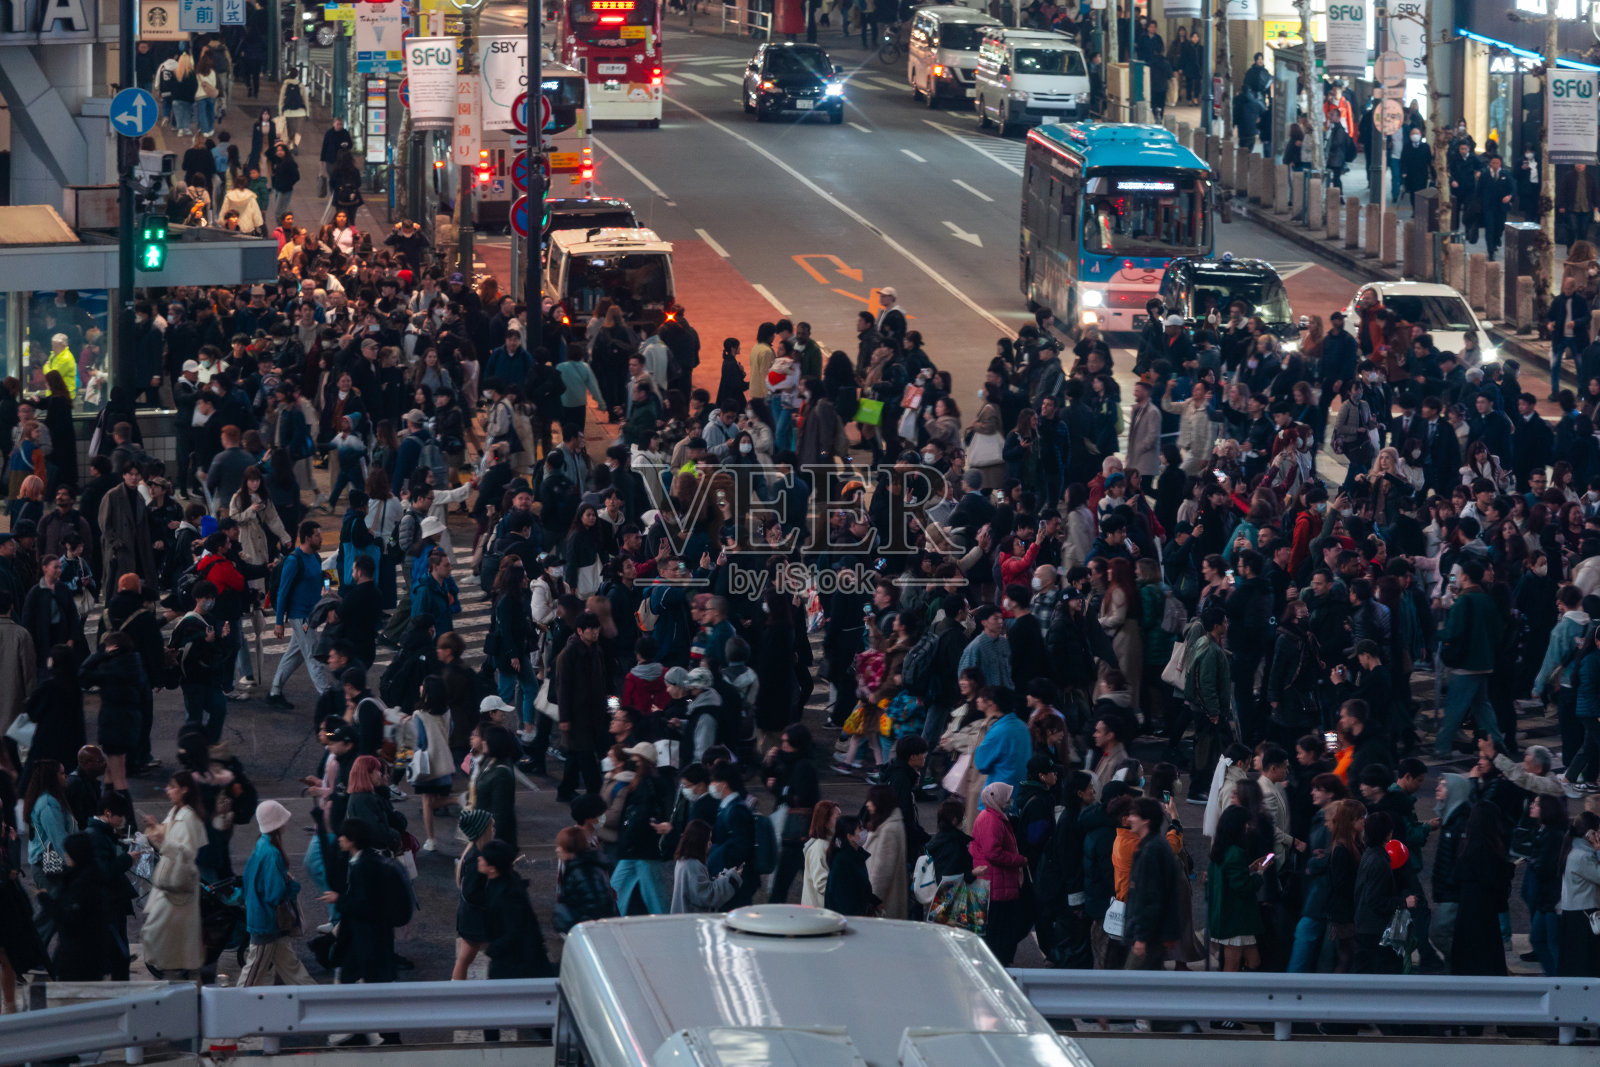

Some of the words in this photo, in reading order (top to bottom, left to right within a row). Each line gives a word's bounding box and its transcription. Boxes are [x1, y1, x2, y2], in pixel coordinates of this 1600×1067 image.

[1329, 5, 1363, 21] SFW
[491, 41, 518, 53] SBY
[412, 47, 452, 66] SFW
[517, 55, 528, 67] T
[1413, 57, 1421, 68] S
[1552, 79, 1592, 98] SFW
[457, 81, 471, 157] 公園通り
